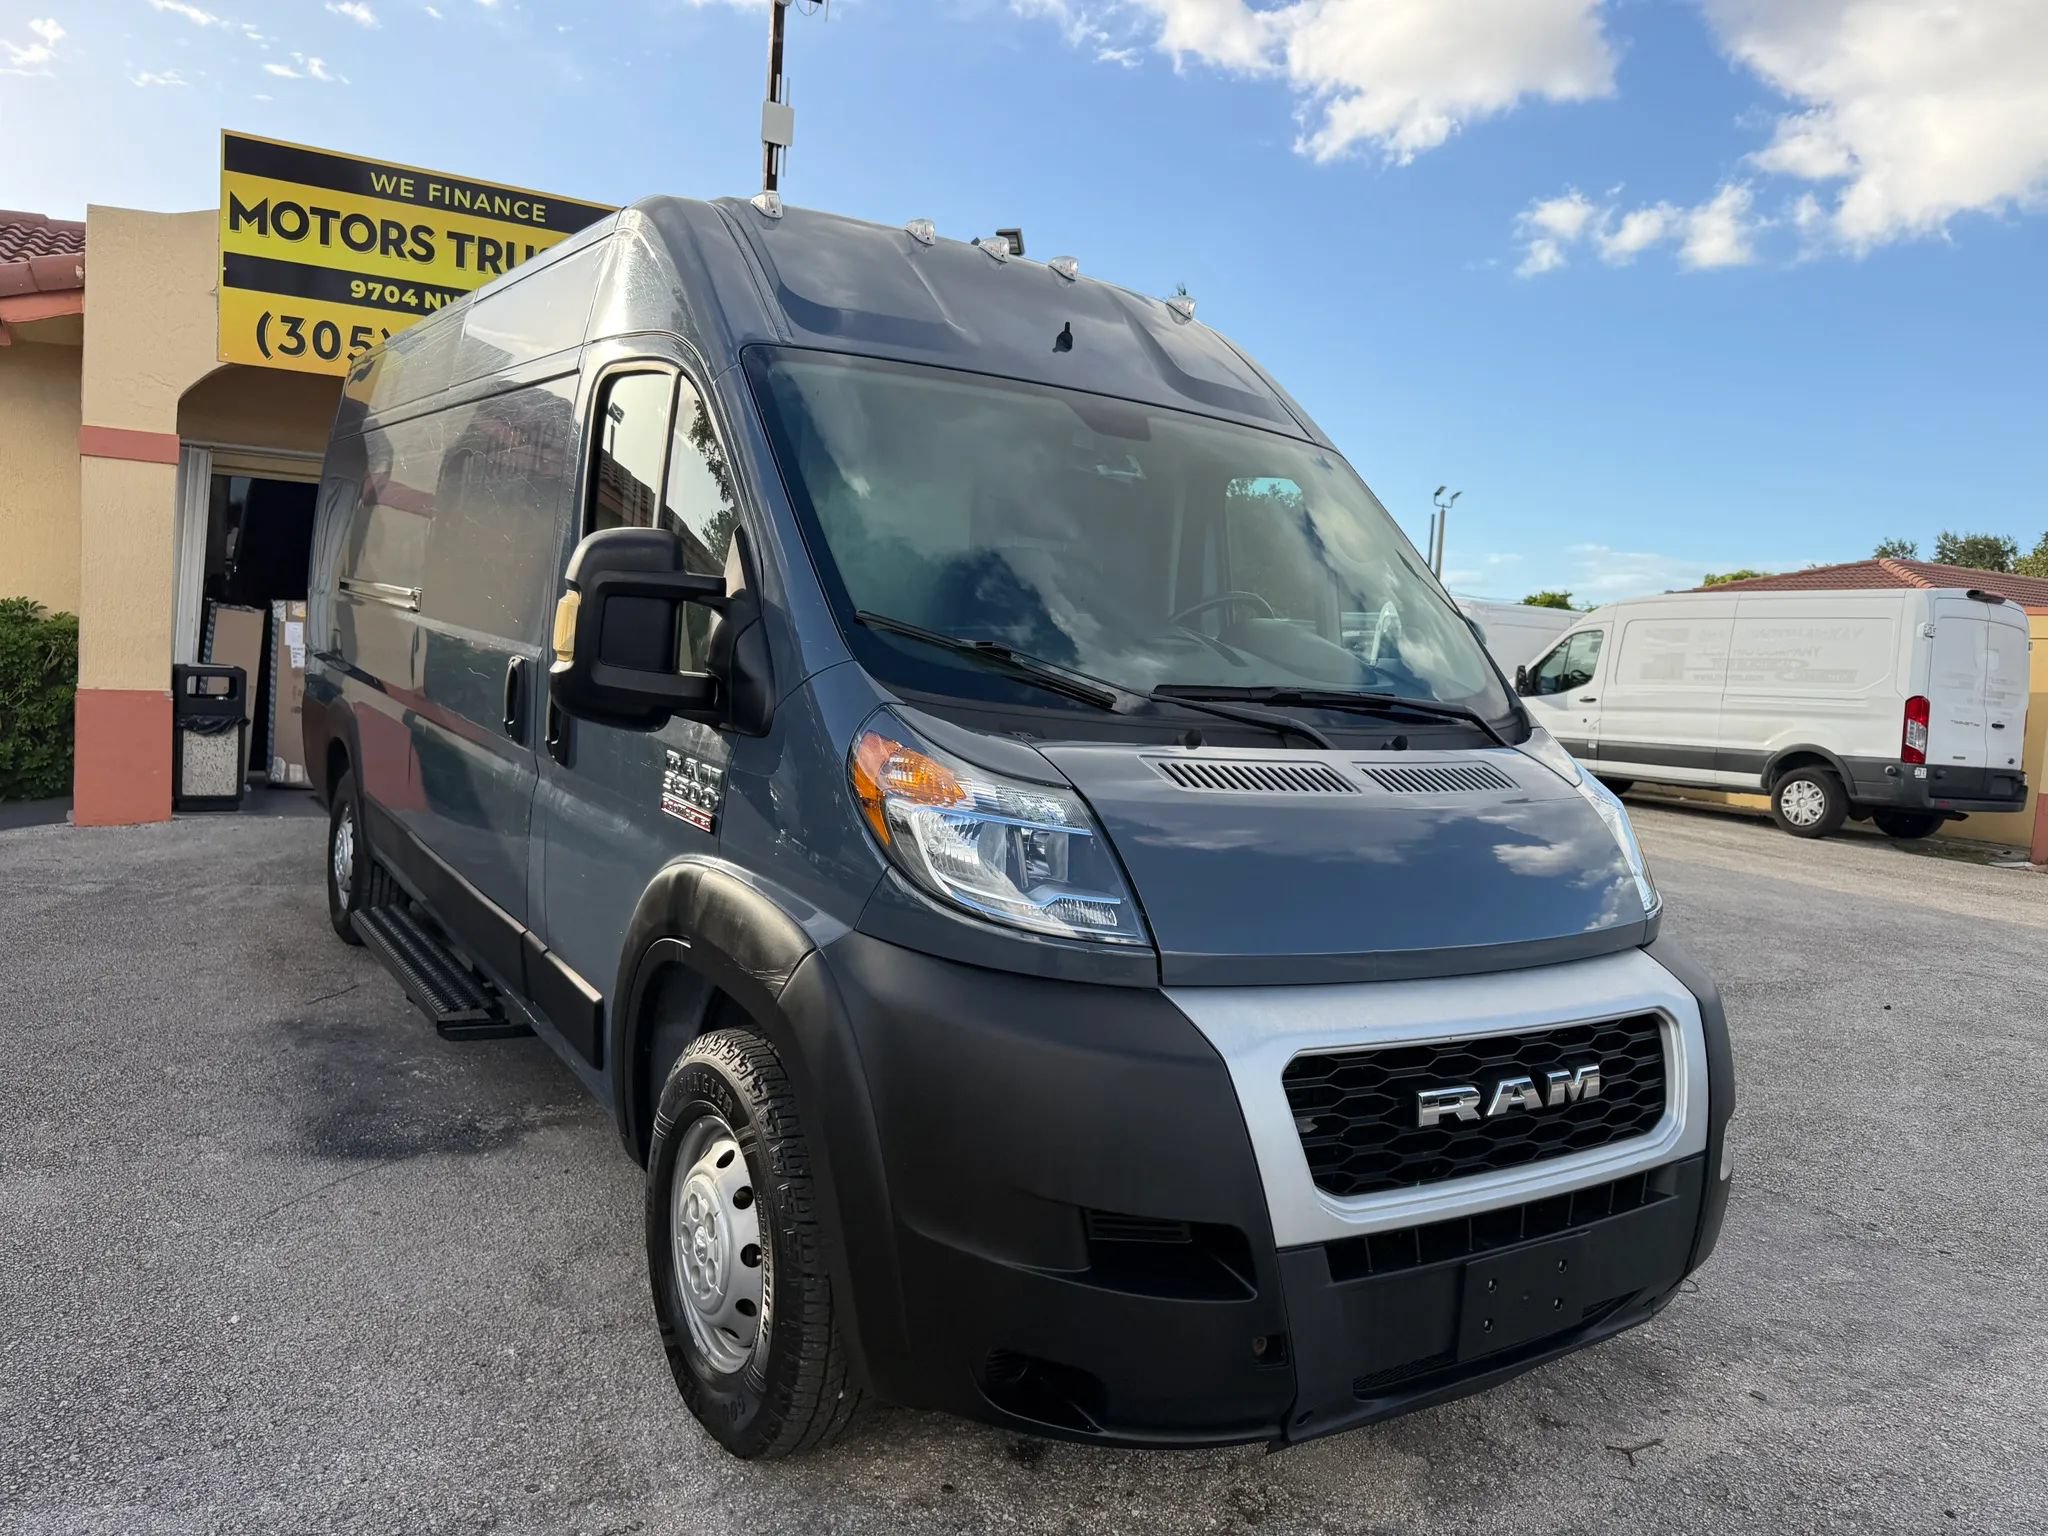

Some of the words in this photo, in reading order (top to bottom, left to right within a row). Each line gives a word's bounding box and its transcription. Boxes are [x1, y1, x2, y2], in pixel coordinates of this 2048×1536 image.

[371, 172, 415, 197] WE
[428, 182, 547, 223] FINANCE
[229, 191, 436, 264] MOTORS
[446, 230, 548, 275] TRU
[350, 280, 418, 307] 9704
[666, 749, 723, 791] RAM
[1417, 1064, 1600, 1128] RAM
